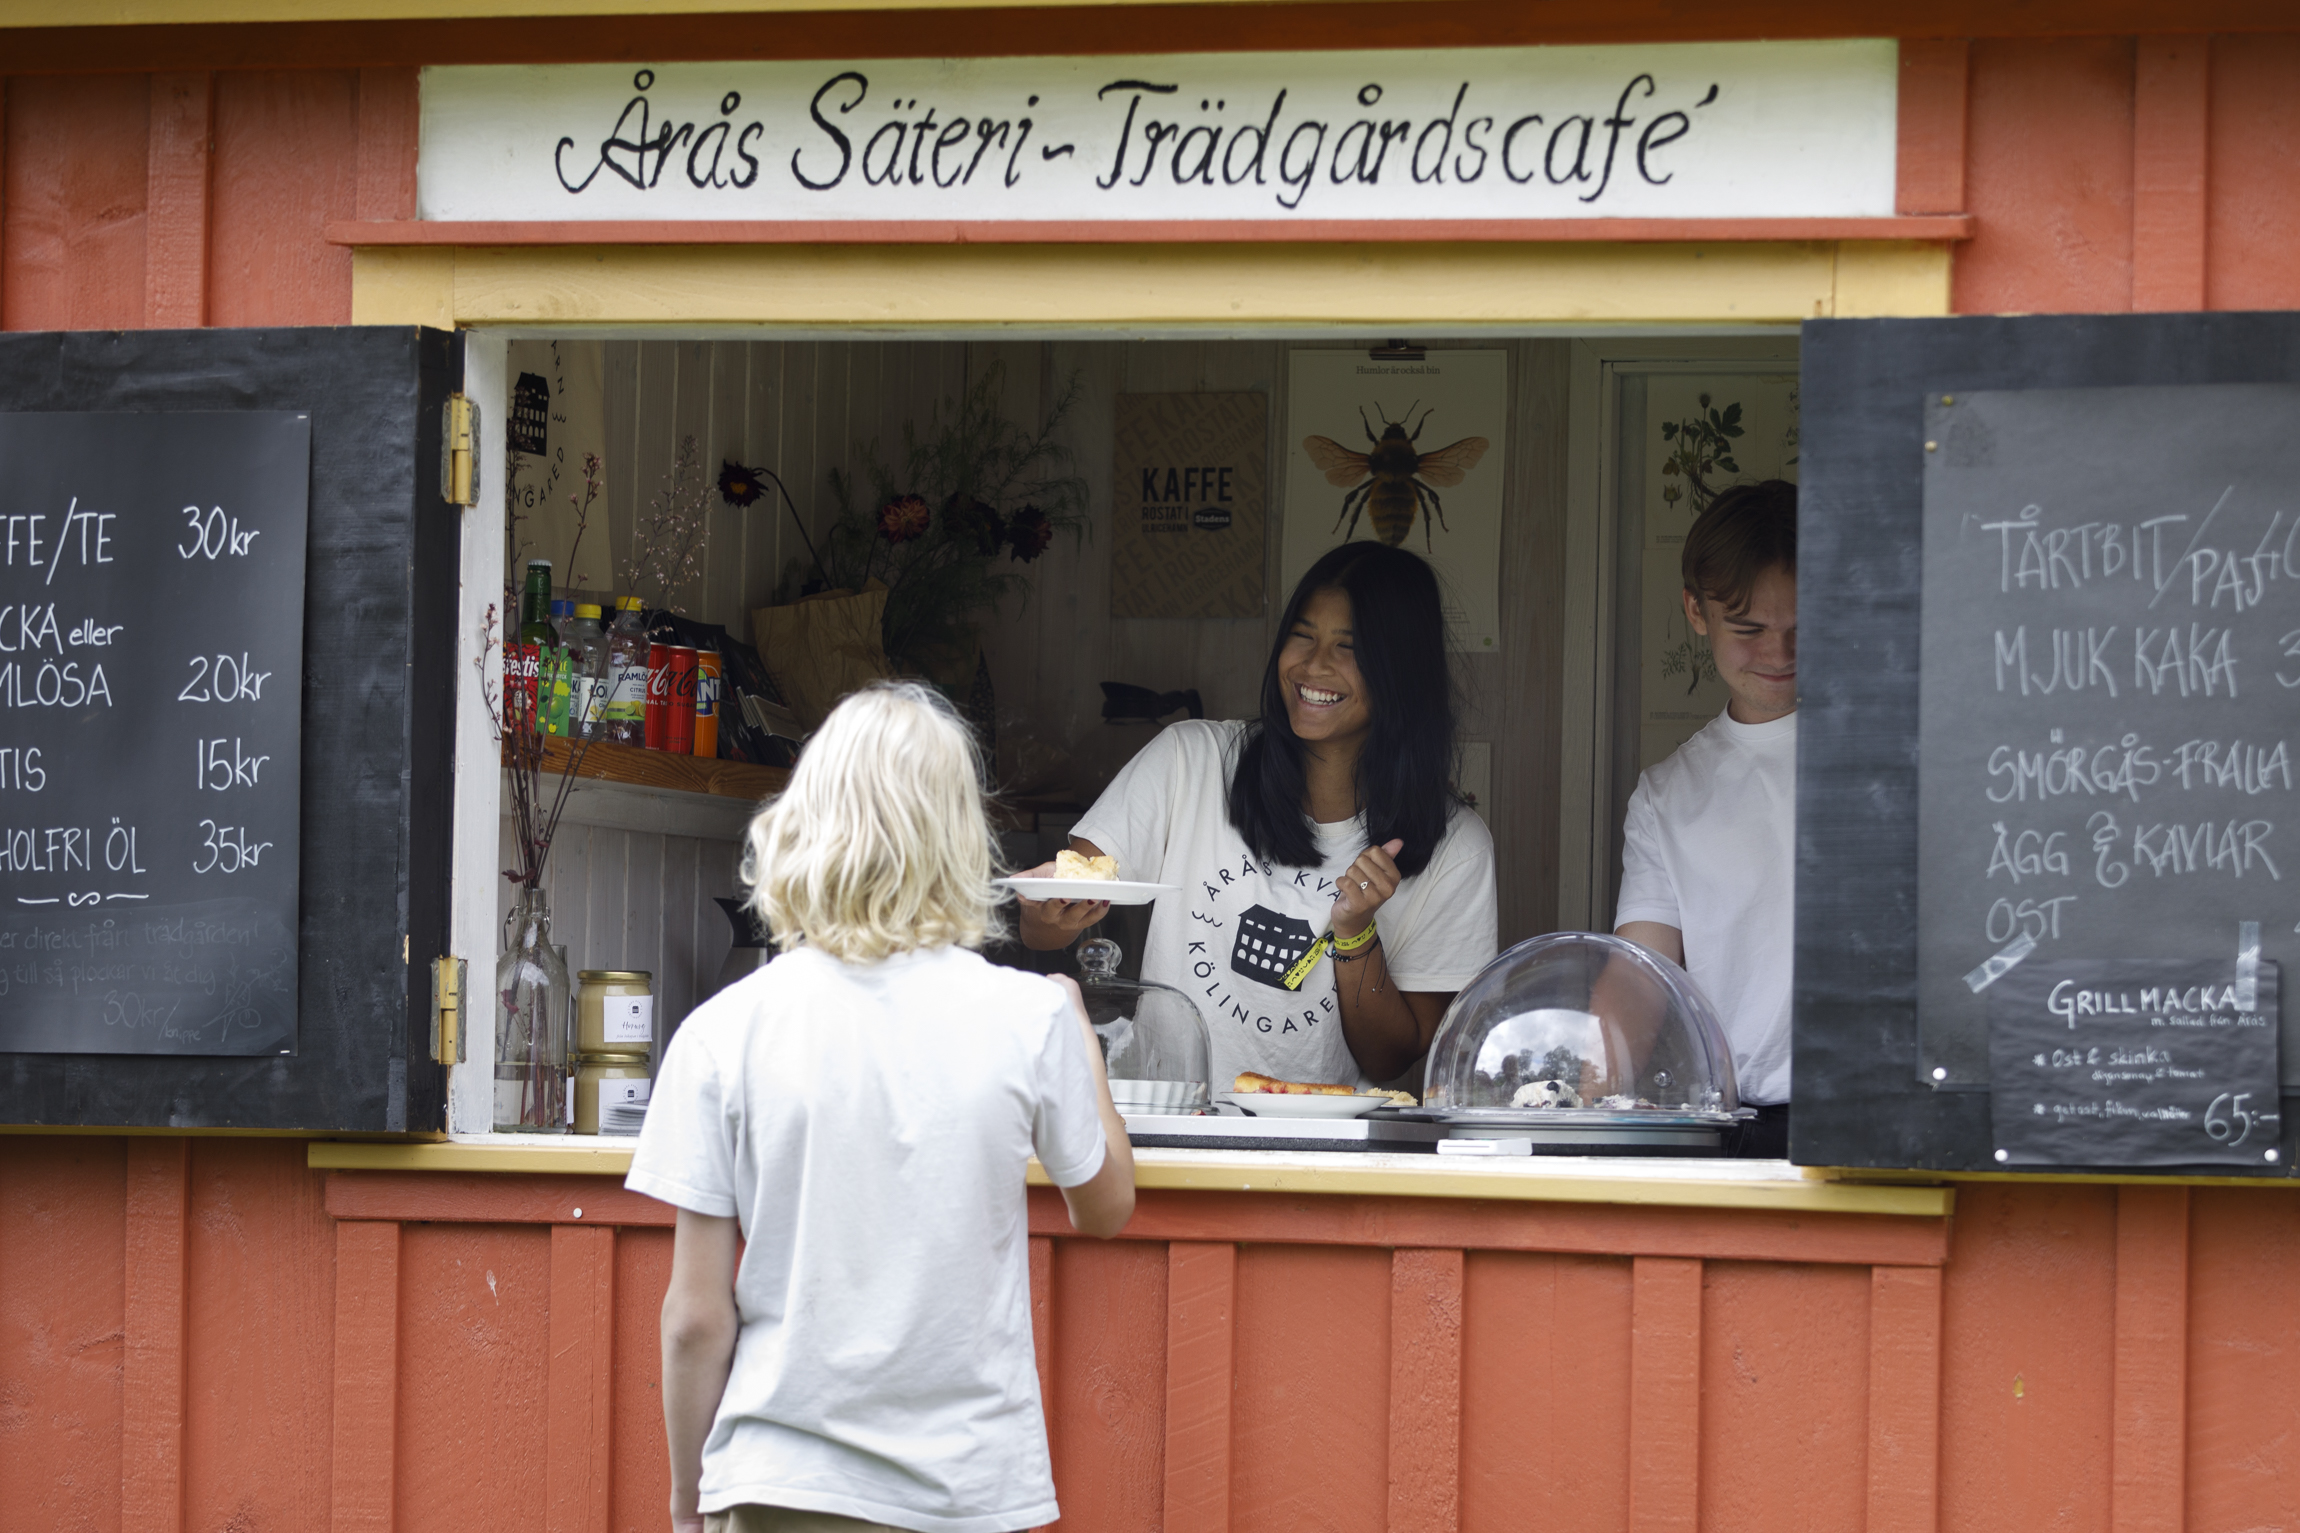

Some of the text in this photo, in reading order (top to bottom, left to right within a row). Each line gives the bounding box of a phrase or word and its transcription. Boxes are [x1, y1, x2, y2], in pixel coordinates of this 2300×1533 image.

[556, 69, 764, 193] Årås
[1356, 365, 1390, 375] Humlor
[1426, 365, 1441, 375] bin
[1142, 467, 1233, 503] KAFFE
[0, 497, 260, 584] FE/TE 30kr
[1195, 514, 1230, 524] Stadens
[69, 619, 123, 646] eller
[178, 652, 271, 702] 20kr
[2135, 622, 2238, 697] KAKA
[198, 738, 270, 790] 15kr
[106, 817, 146, 873] ÖL
[194, 819, 273, 873] 35kr
[2133, 819, 2280, 881] KAVIAR
[1202, 854, 1274, 902] ÅRÅS
[24, 926, 83, 952] direkt
[84, 918, 130, 959] från
[1986, 897, 2078, 943] OST
[13, 960, 38, 985] till
[43, 958, 64, 988] så
[69, 960, 136, 996] plockar
[184, 963, 217, 997] dig
[1188, 941, 1338, 1034] KÖLINGARE
